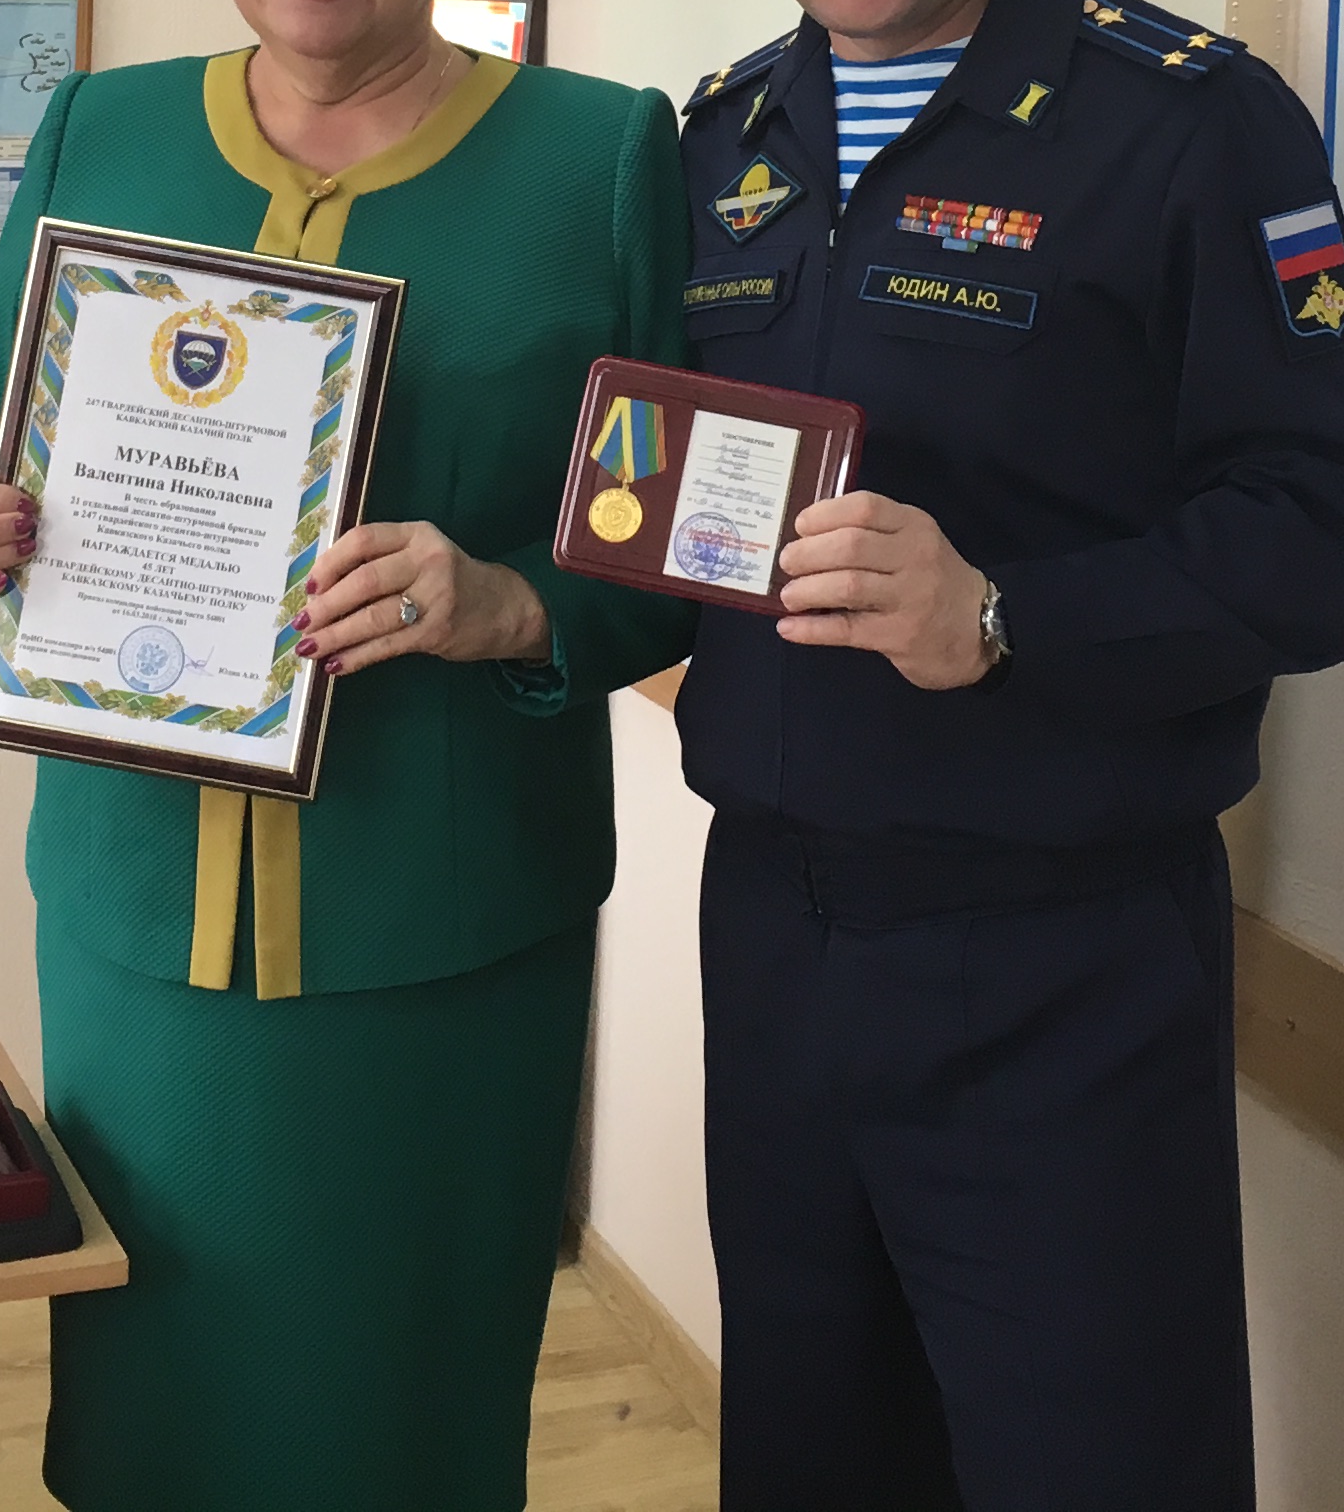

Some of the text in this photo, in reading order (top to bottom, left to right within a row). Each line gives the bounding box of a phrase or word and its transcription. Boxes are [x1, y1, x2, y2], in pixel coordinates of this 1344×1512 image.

[741, 278, 774, 295] РОССИИ
[886, 275, 1003, 313] ЮДИН А.Ю.
[101, 400, 170, 419] ГВАРДЕЙСКИЙ
[171, 411, 287, 439] ДЕСАНТНО-ШТУРМОВОЙ
[116, 413, 254, 443] КАВКАЗСКИЙ КАЗАЧИЙ ПОЛК
[114, 445, 240, 481] МУРАВЬЁВА
[73, 462, 274, 510] Валентина Николаевна
[81, 510, 97, 520] 247
[81, 538, 241, 574] НАГРАЖДАЕТСЯ МЕДАЛЬЮ
[141, 562, 176, 575] 45 ЛЕТ
[49, 557, 135, 581] ГВАРДЕЙСКОМУ
[136, 572, 278, 605] ДЕСАНТНО-ШТУРМОВОМУ
[61, 573, 248, 612] КАВКАЗСКОМУ КАЗАЧЬЕМУ ПОЛКУ
